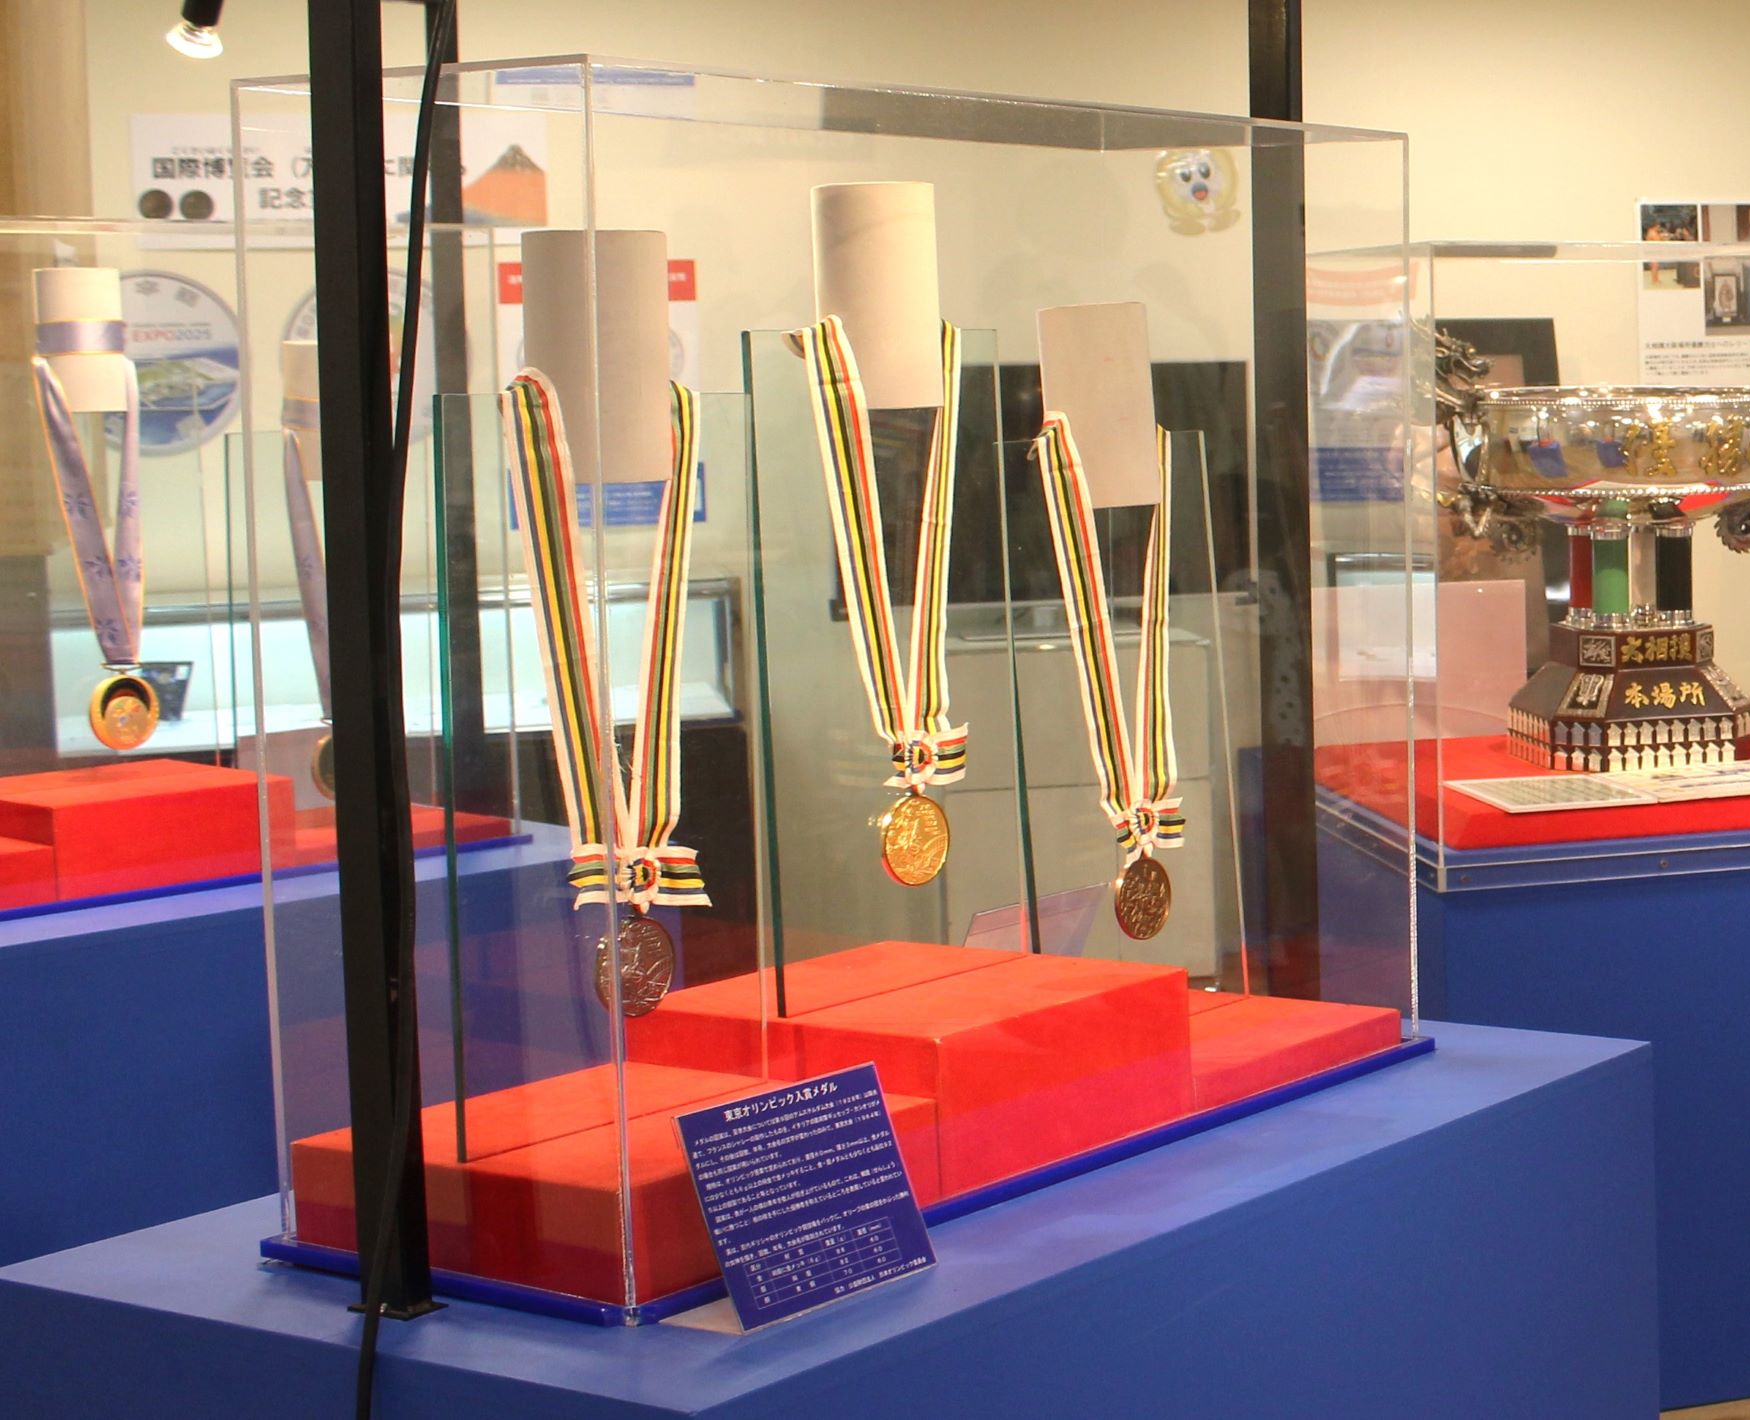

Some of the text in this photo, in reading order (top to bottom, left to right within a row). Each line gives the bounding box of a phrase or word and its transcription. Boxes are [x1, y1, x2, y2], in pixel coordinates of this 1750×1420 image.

[1620, 632, 1693, 664] 大相撲
[1624, 681, 1706, 709] 本場所
[723, 1081, 838, 1122] 東京オリンピック入賞メダル
